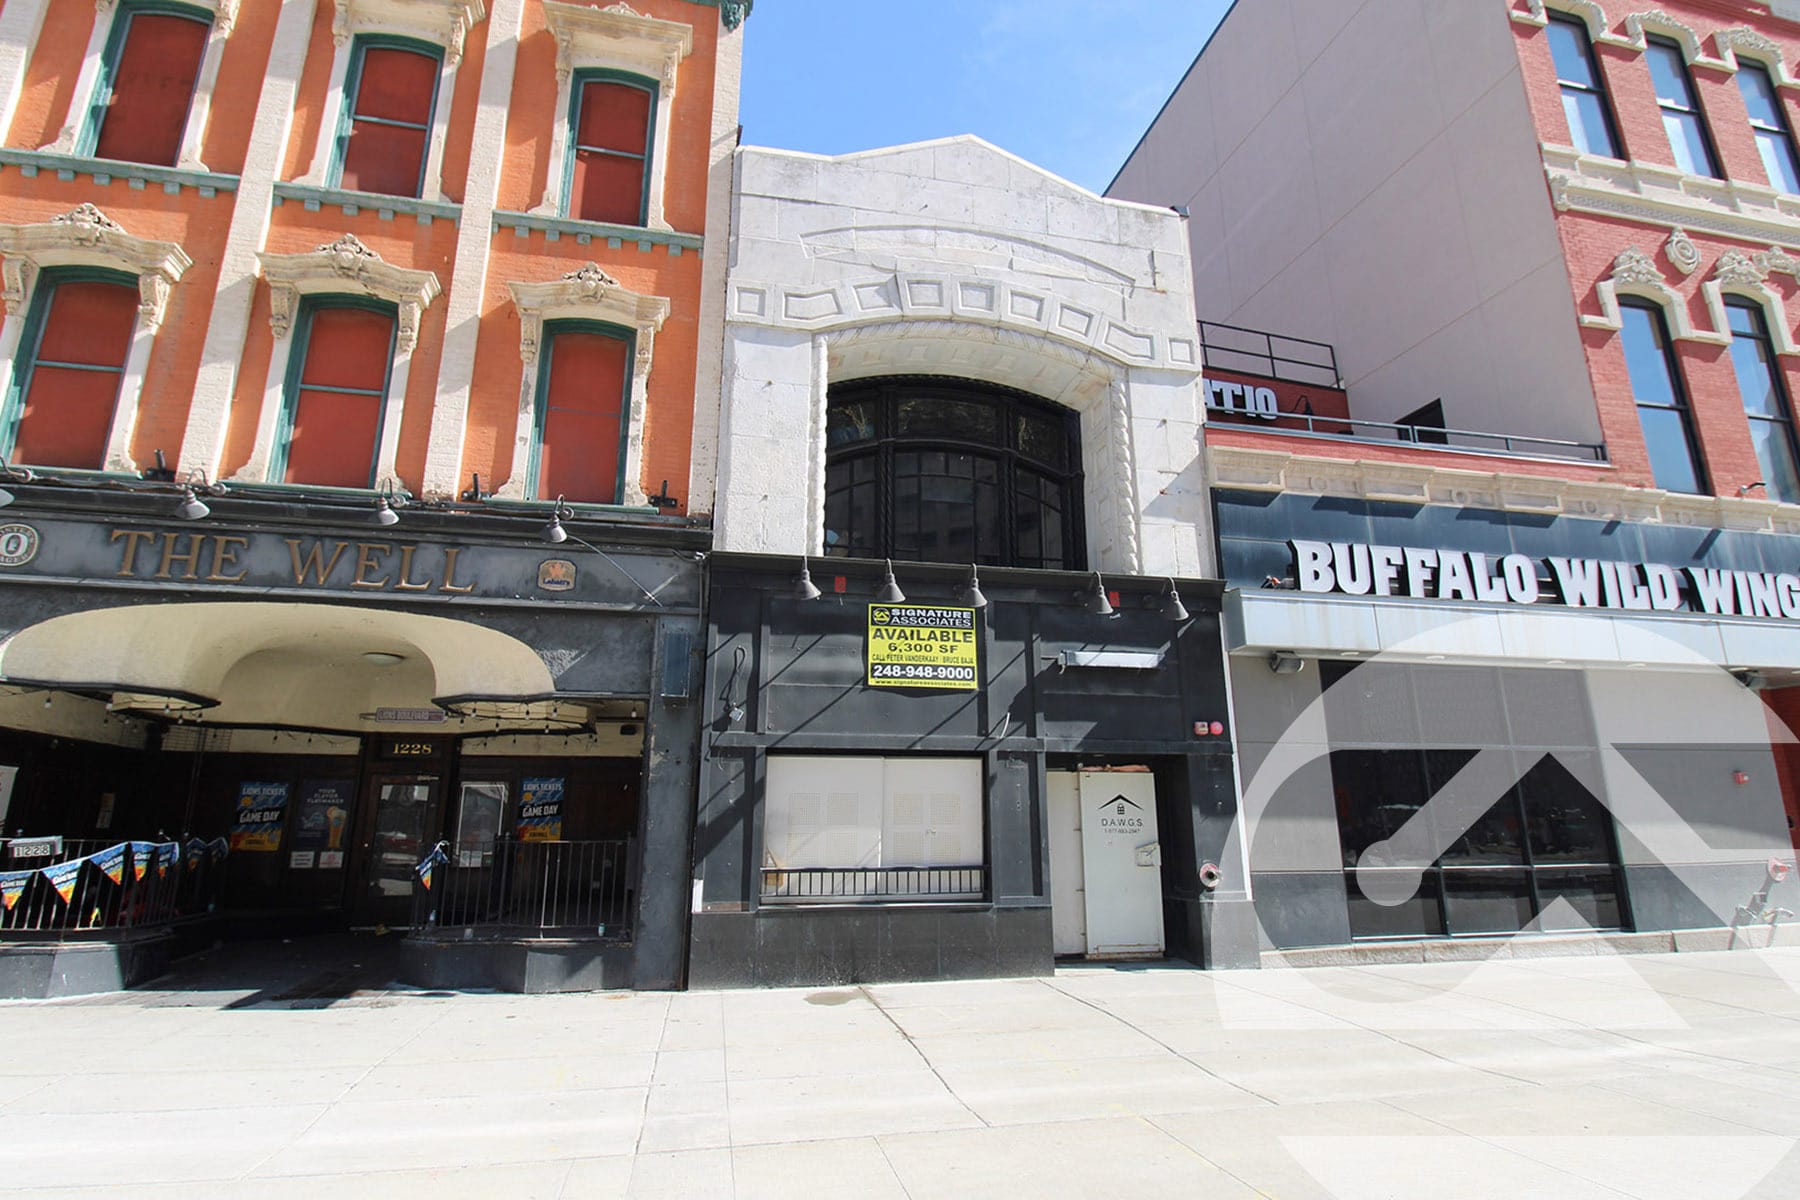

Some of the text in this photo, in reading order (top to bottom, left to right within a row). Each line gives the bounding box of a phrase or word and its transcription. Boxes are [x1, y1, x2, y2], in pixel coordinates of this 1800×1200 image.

[111, 529, 478, 593] THE WELL
[1292, 539, 1800, 618] BUFFALO WILD WING
[891, 608, 972, 619] SIGNATURE
[890, 617, 972, 627] ASSOCIATES
[872, 628, 973, 643] AVAILABLE
[888, 642, 959, 654] 6,300 SF
[887, 654, 903, 662] PETER
[943, 656, 960, 664] BRUCE
[873, 665, 973, 679] 248-948-9000
[393, 743, 432, 755] 1228
[262, 786, 286, 796] TICKETS
[540, 783, 562, 791] TICKETS
[240, 809, 281, 824] GAME DAY
[522, 804, 559, 817] GAME DAY
[16, 844, 49, 856] 1228
